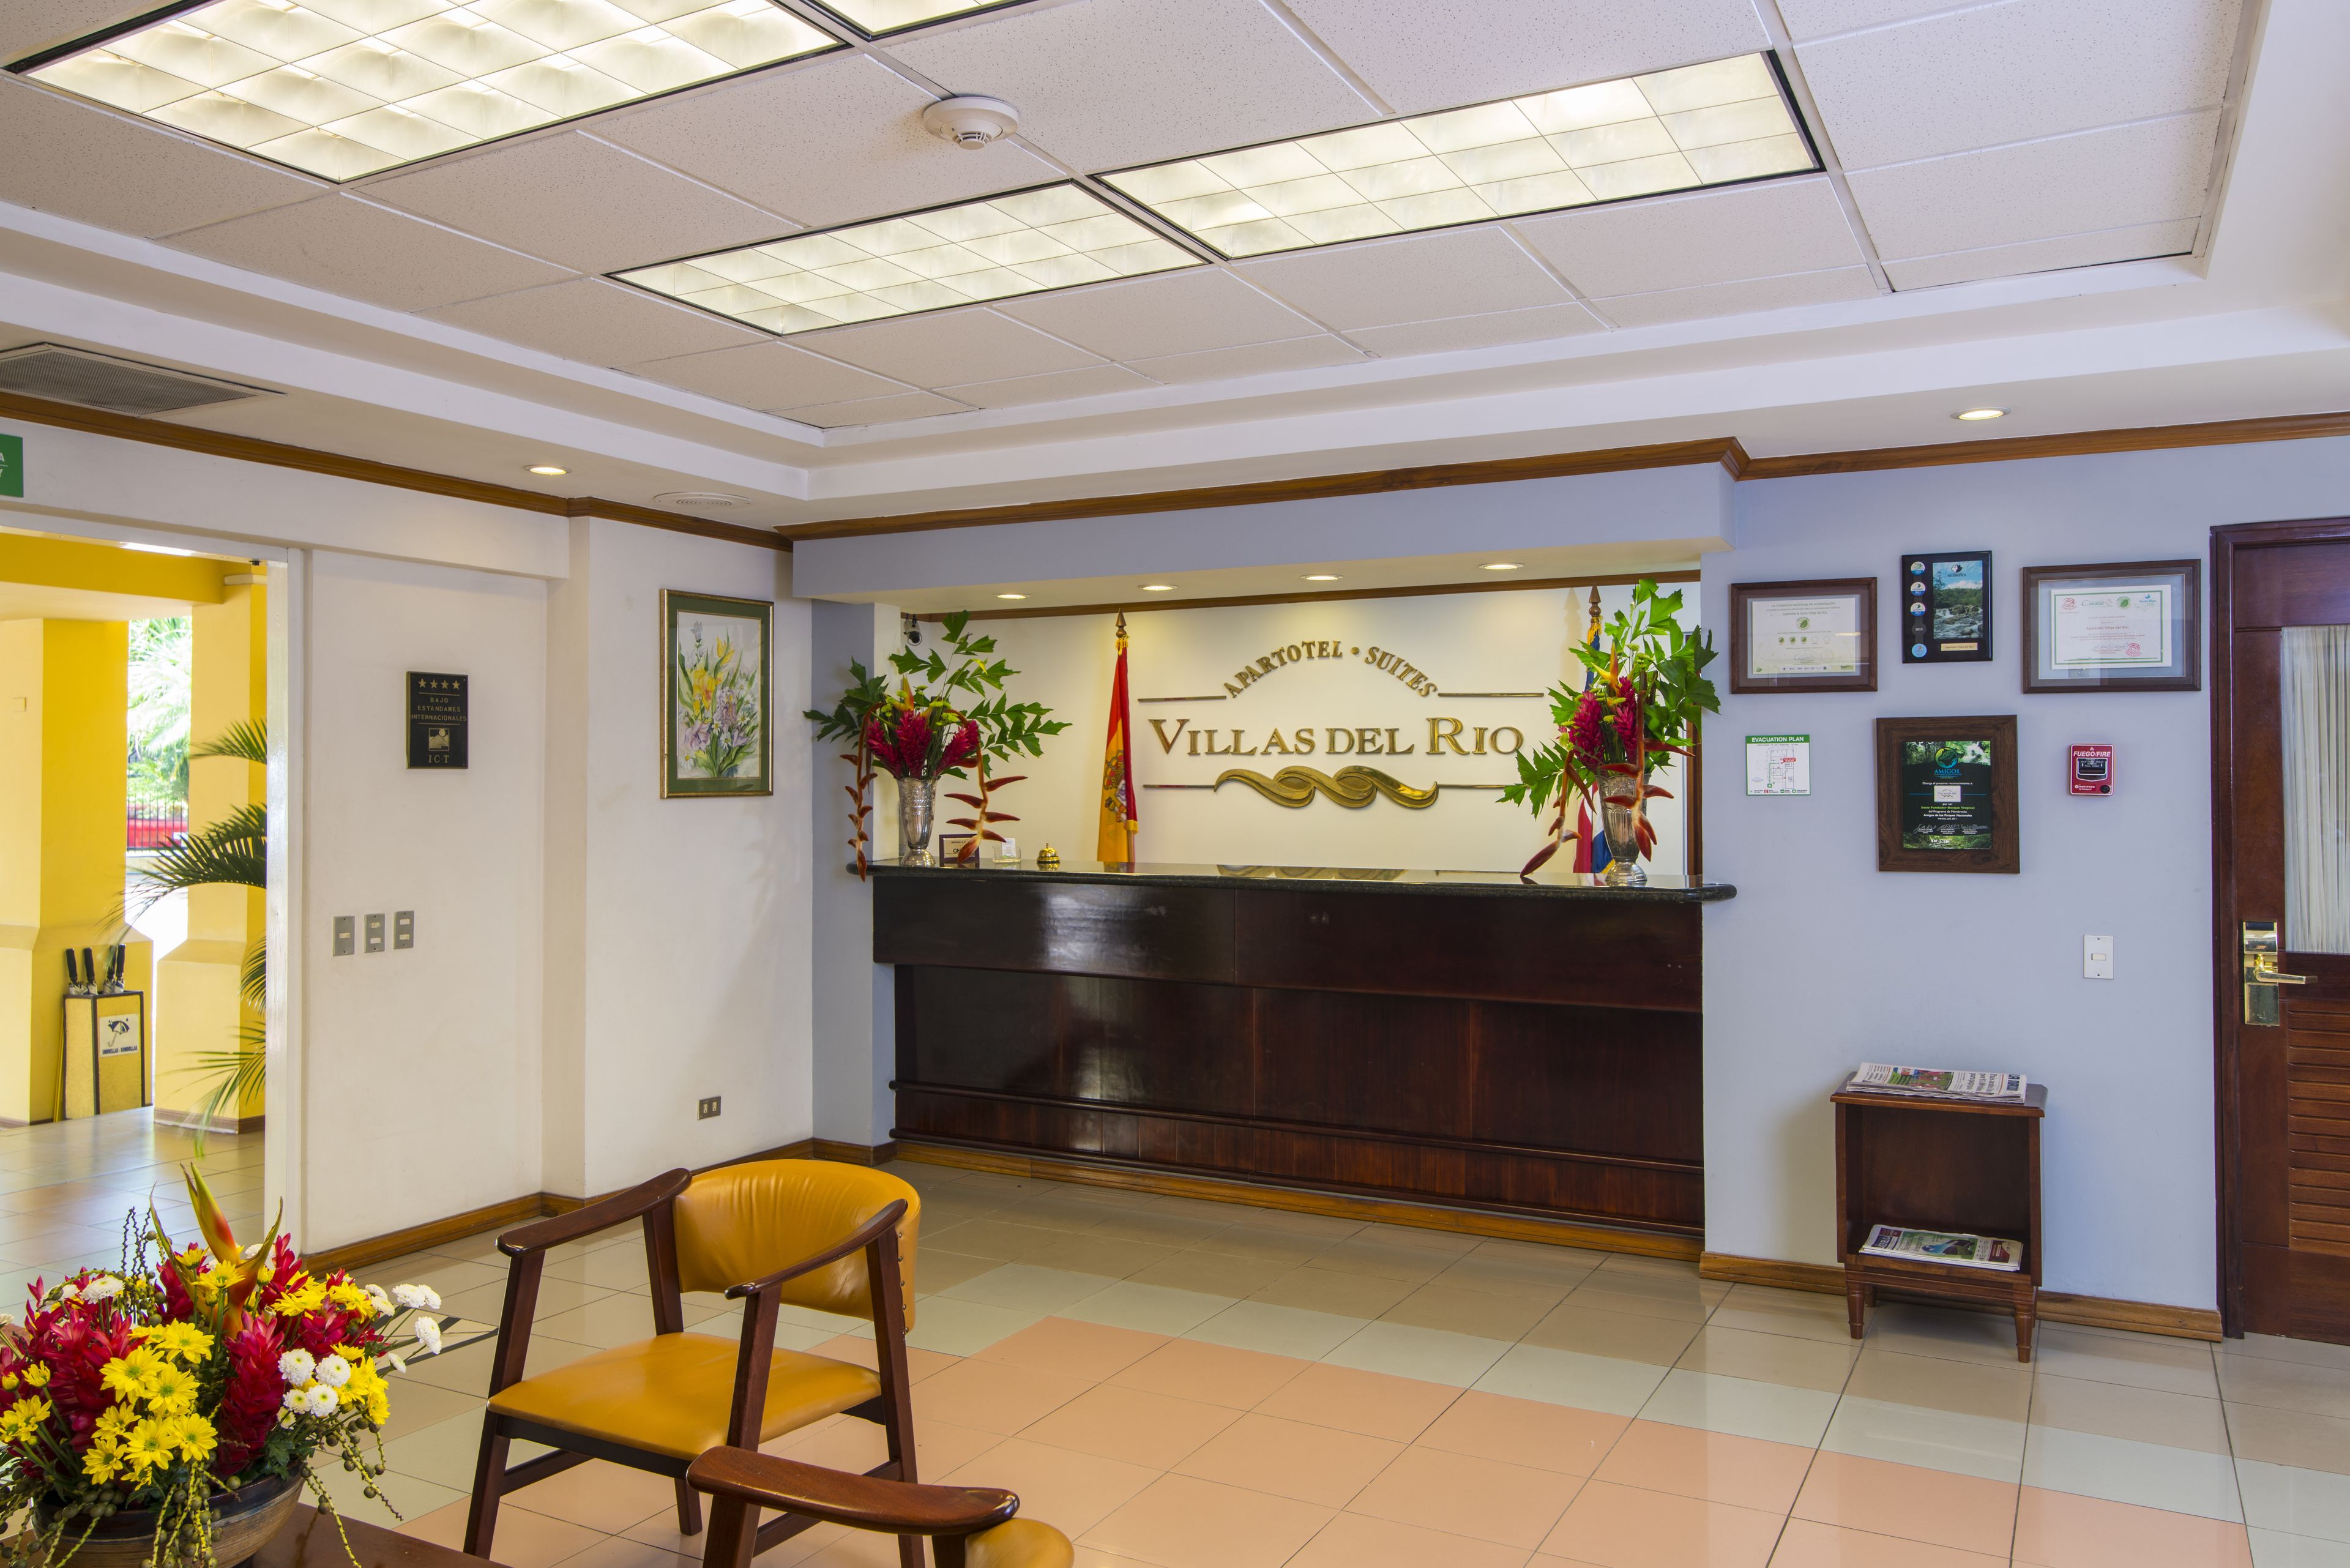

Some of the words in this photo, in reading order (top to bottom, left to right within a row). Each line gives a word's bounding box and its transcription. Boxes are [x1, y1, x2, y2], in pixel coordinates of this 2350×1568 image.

[1225, 640, 1343, 698] APARTOTEL
[1365, 646, 1439, 697] SUITES
[411, 714, 466, 722] INTERNACIONALES
[1148, 718, 1317, 756] VILLAS
[1325, 727, 1414, 755] DEL
[1425, 717, 1524, 756] RIO
